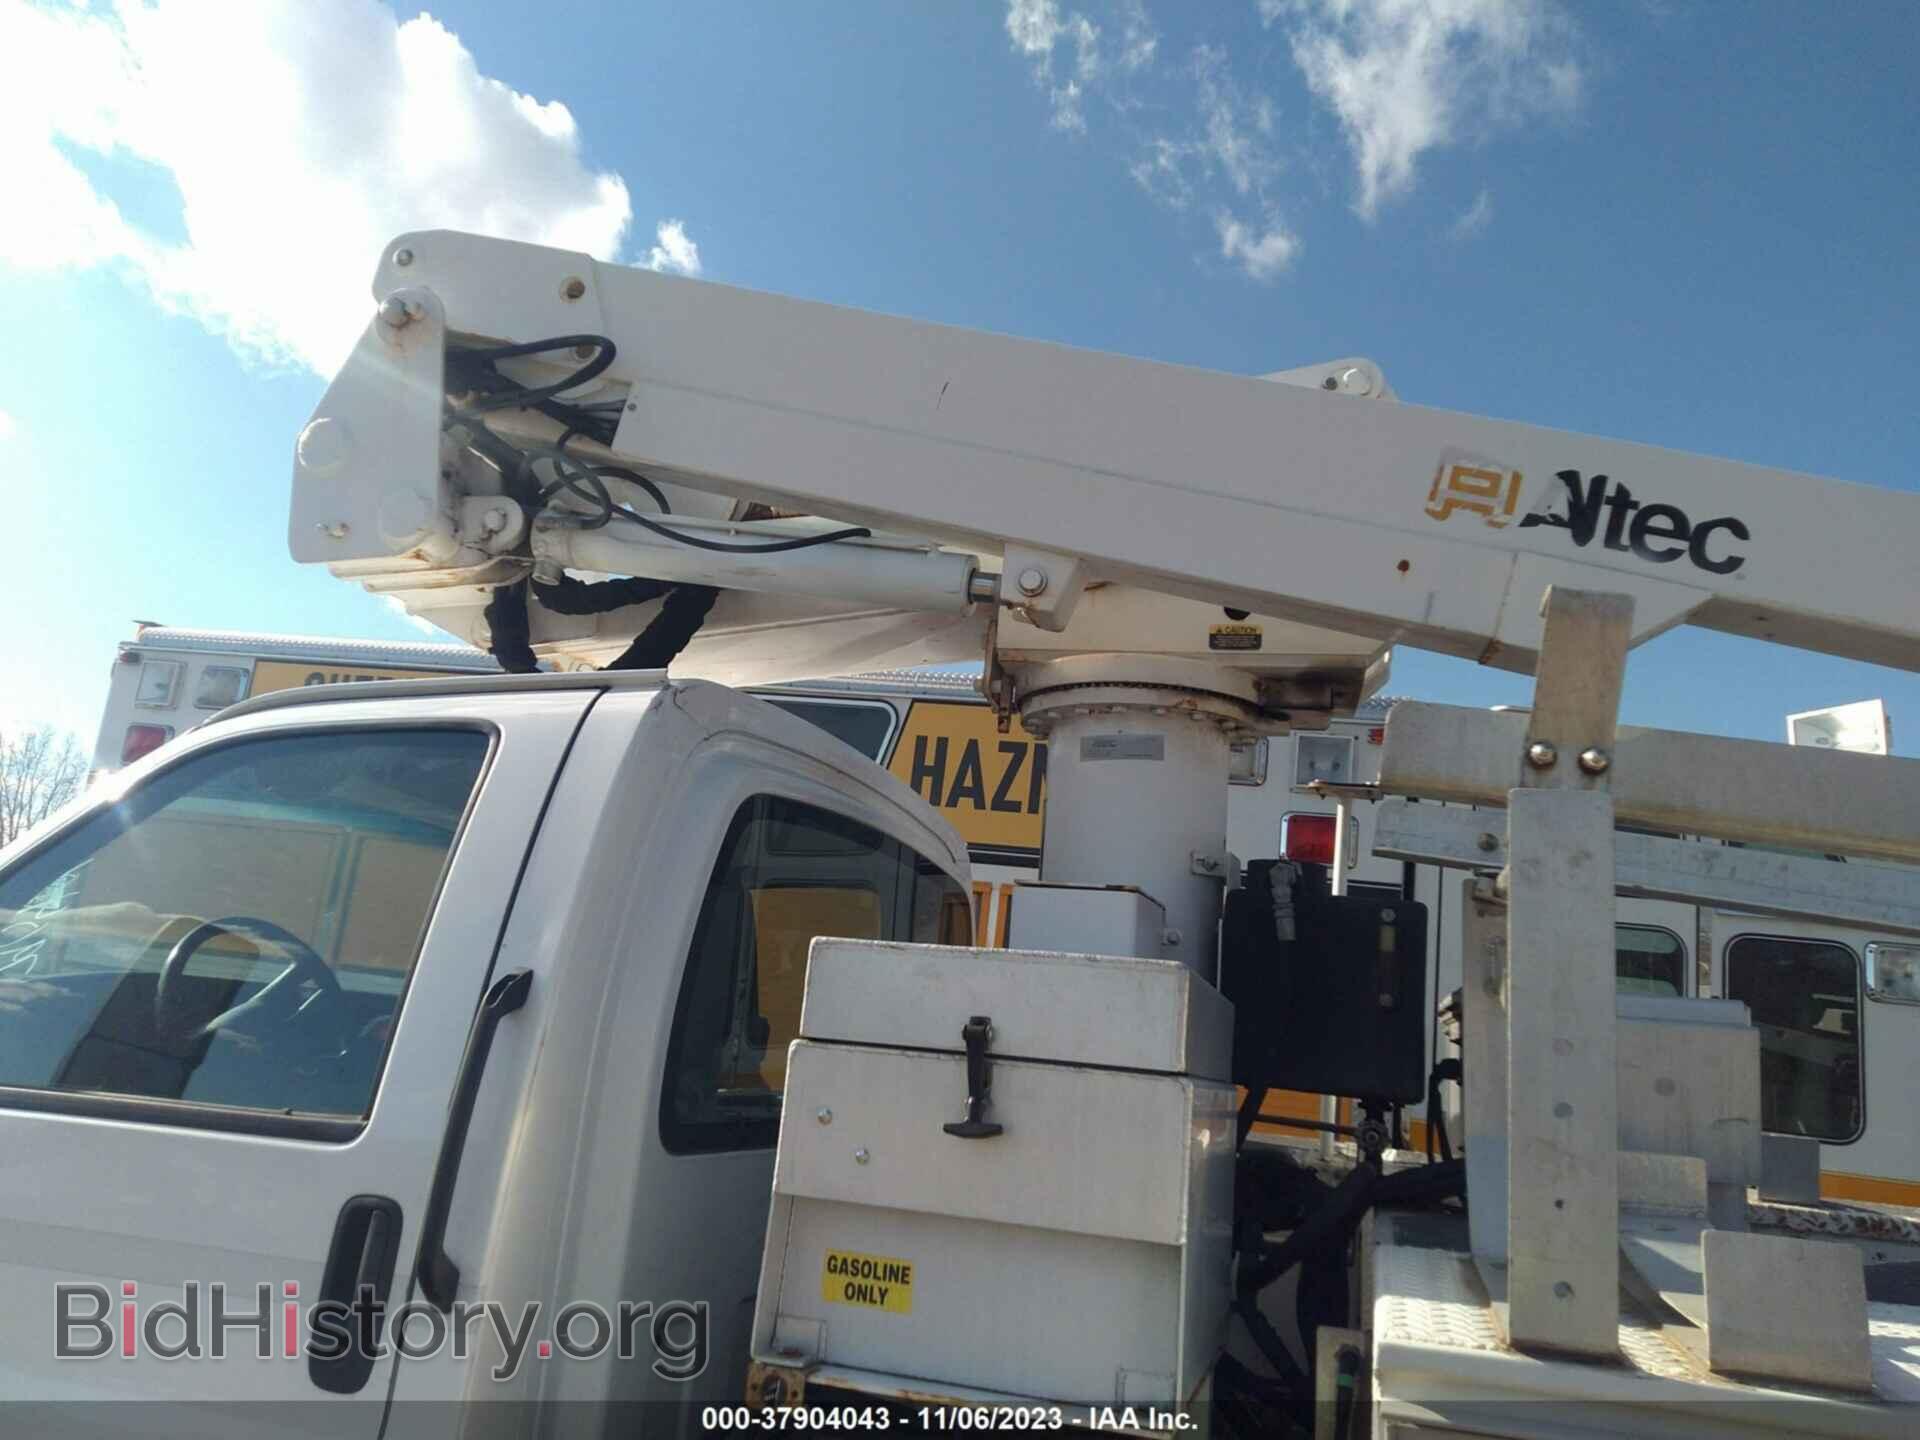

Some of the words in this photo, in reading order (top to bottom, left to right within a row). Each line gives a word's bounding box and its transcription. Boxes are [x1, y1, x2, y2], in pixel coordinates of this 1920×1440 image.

[1519, 470, 1750, 575] Altec
[827, 1255, 911, 1285] GASOLINE
[844, 1282, 888, 1306] ONLY
